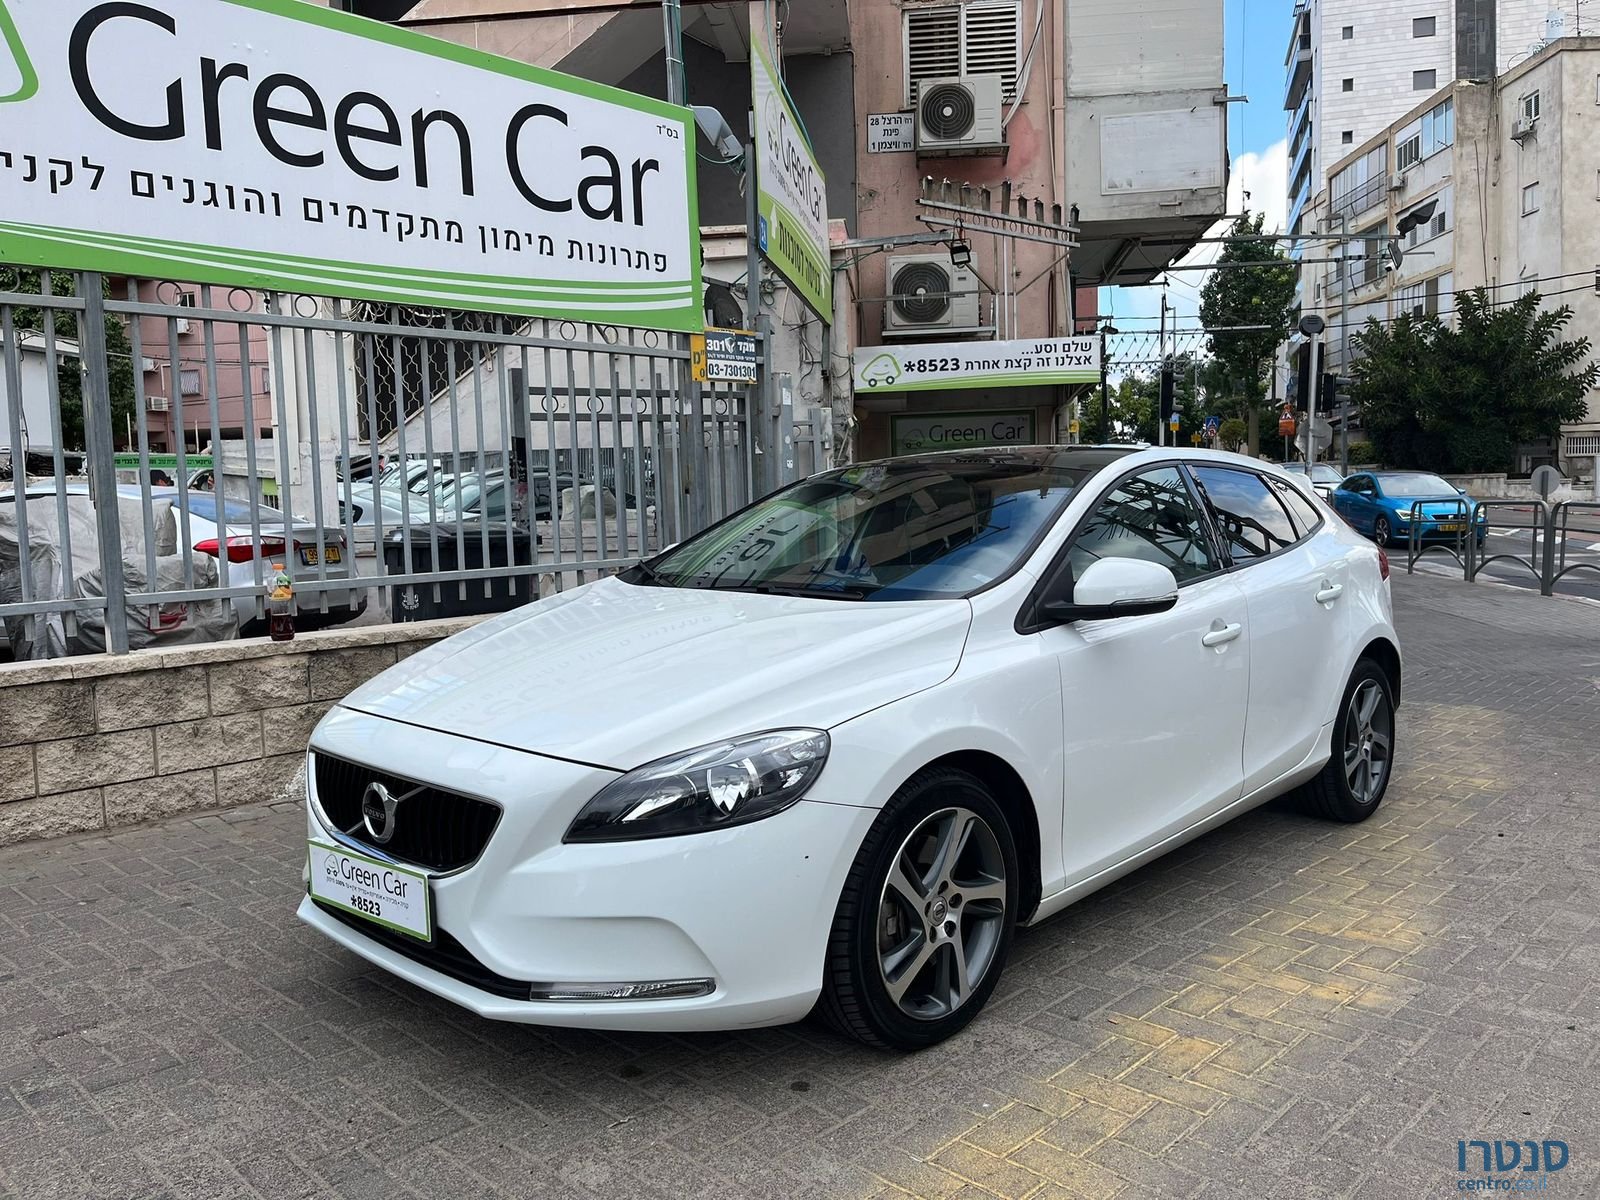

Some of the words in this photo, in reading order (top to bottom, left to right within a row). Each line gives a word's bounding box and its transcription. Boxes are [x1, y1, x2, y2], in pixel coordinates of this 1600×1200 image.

[69, 1, 474, 197] Green
[505, 103, 660, 227] Car
[881, 115, 902, 125] הרצל
[870, 117, 880, 126] 28
[656, 125, 679, 139] בס"ד
[882, 128, 899, 137] פינת
[871, 142, 876, 150] 1
[779, 111, 808, 202] Green
[130, 170, 282, 217] והוגנים
[302, 197, 464, 243] מתקדמים
[478, 225, 554, 257] מימון
[567, 239, 668, 273] פתרונות
[706, 339, 725, 352] 301
[1021, 343, 1057, 355] וסע...
[1062, 341, 1092, 353] שלם
[964, 359, 1001, 371] אחרת
[1004, 358, 1032, 371] קצת
[1036, 359, 1050, 367] זה
[1055, 354, 1093, 367] אצלנו
[708, 362, 756, 378] 03-7301301
[928, 424, 986, 443] Green
[991, 421, 1025, 442] Car
[364, 806, 385, 819] VOLVO
[340, 857, 381, 890] Green
[382, 871, 408, 899] Car
